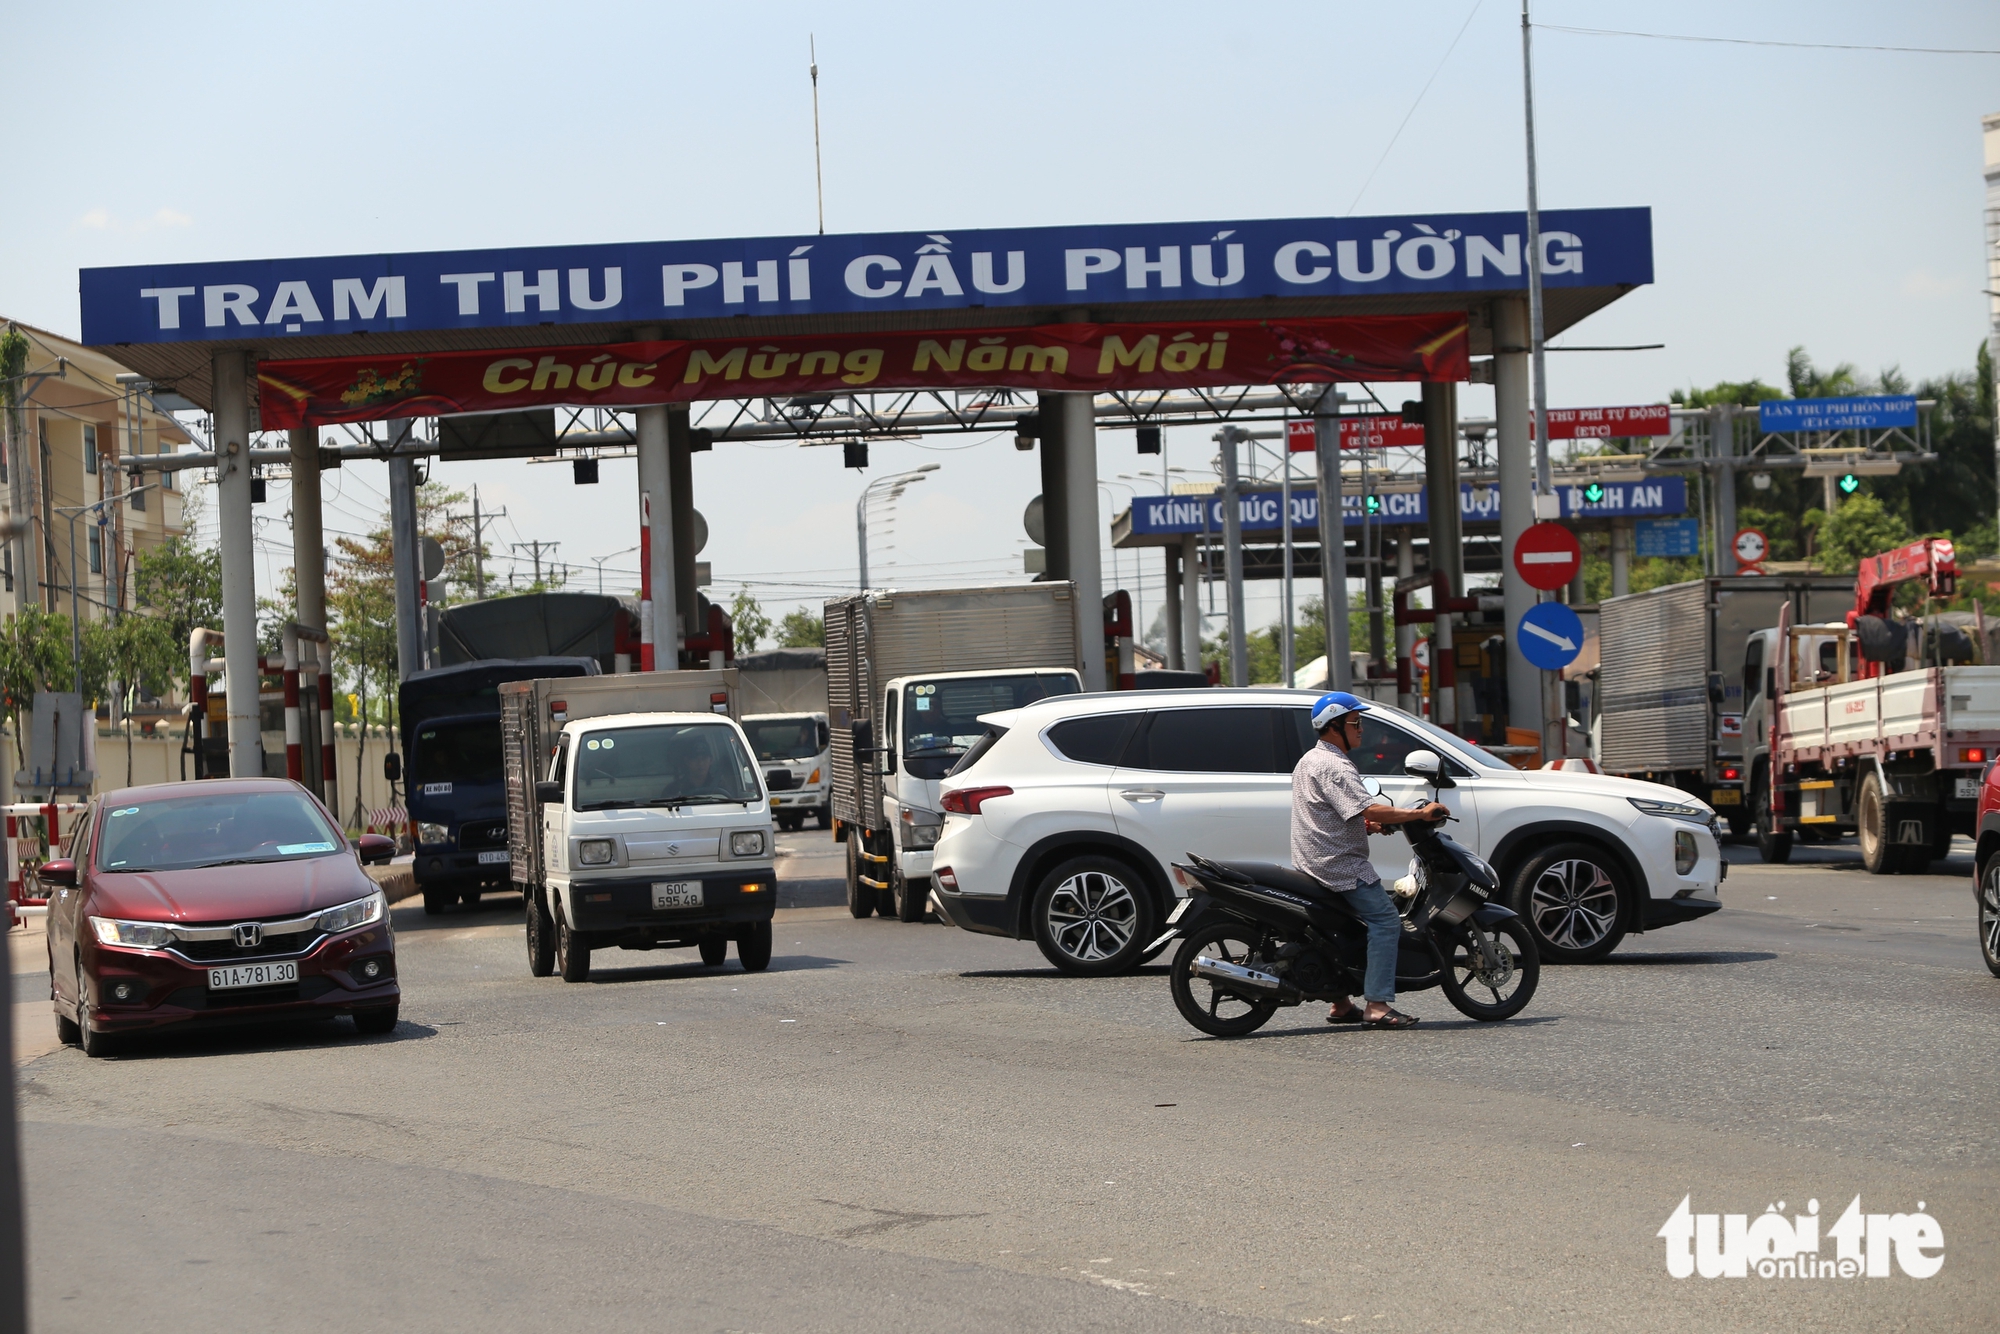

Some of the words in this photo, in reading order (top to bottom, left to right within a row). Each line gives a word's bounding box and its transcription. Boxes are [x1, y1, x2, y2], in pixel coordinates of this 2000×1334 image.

[140, 275, 407, 332] TRẠM
[440, 266, 623, 315] THU
[662, 244, 814, 307] PHÍ
[844, 234, 1026, 298] CẦU
[1065, 230, 1246, 290] PHÚ
[1274, 222, 1584, 284] CƯỜNG
[482, 353, 657, 394] Chúc
[684, 345, 884, 385] Mừng
[912, 336, 1070, 375] Năm
[1097, 331, 1230, 375] Mới
[1548, 411, 1575, 422] THU
[1796, 404, 1824, 416] THU
[1150, 498, 1206, 526] KÍNH
[1289, 497, 1322, 523] QU
[1568, 485, 1624, 511] BNH
[1631, 485, 1663, 508] AN
[666, 883, 688, 895] 60C
[1263, 888, 1313, 906] NOUVO
[1468, 882, 1489, 899] YAMAHA
[658, 894, 698, 908] 595.48
[212, 963, 295, 987] 61A-781.30
